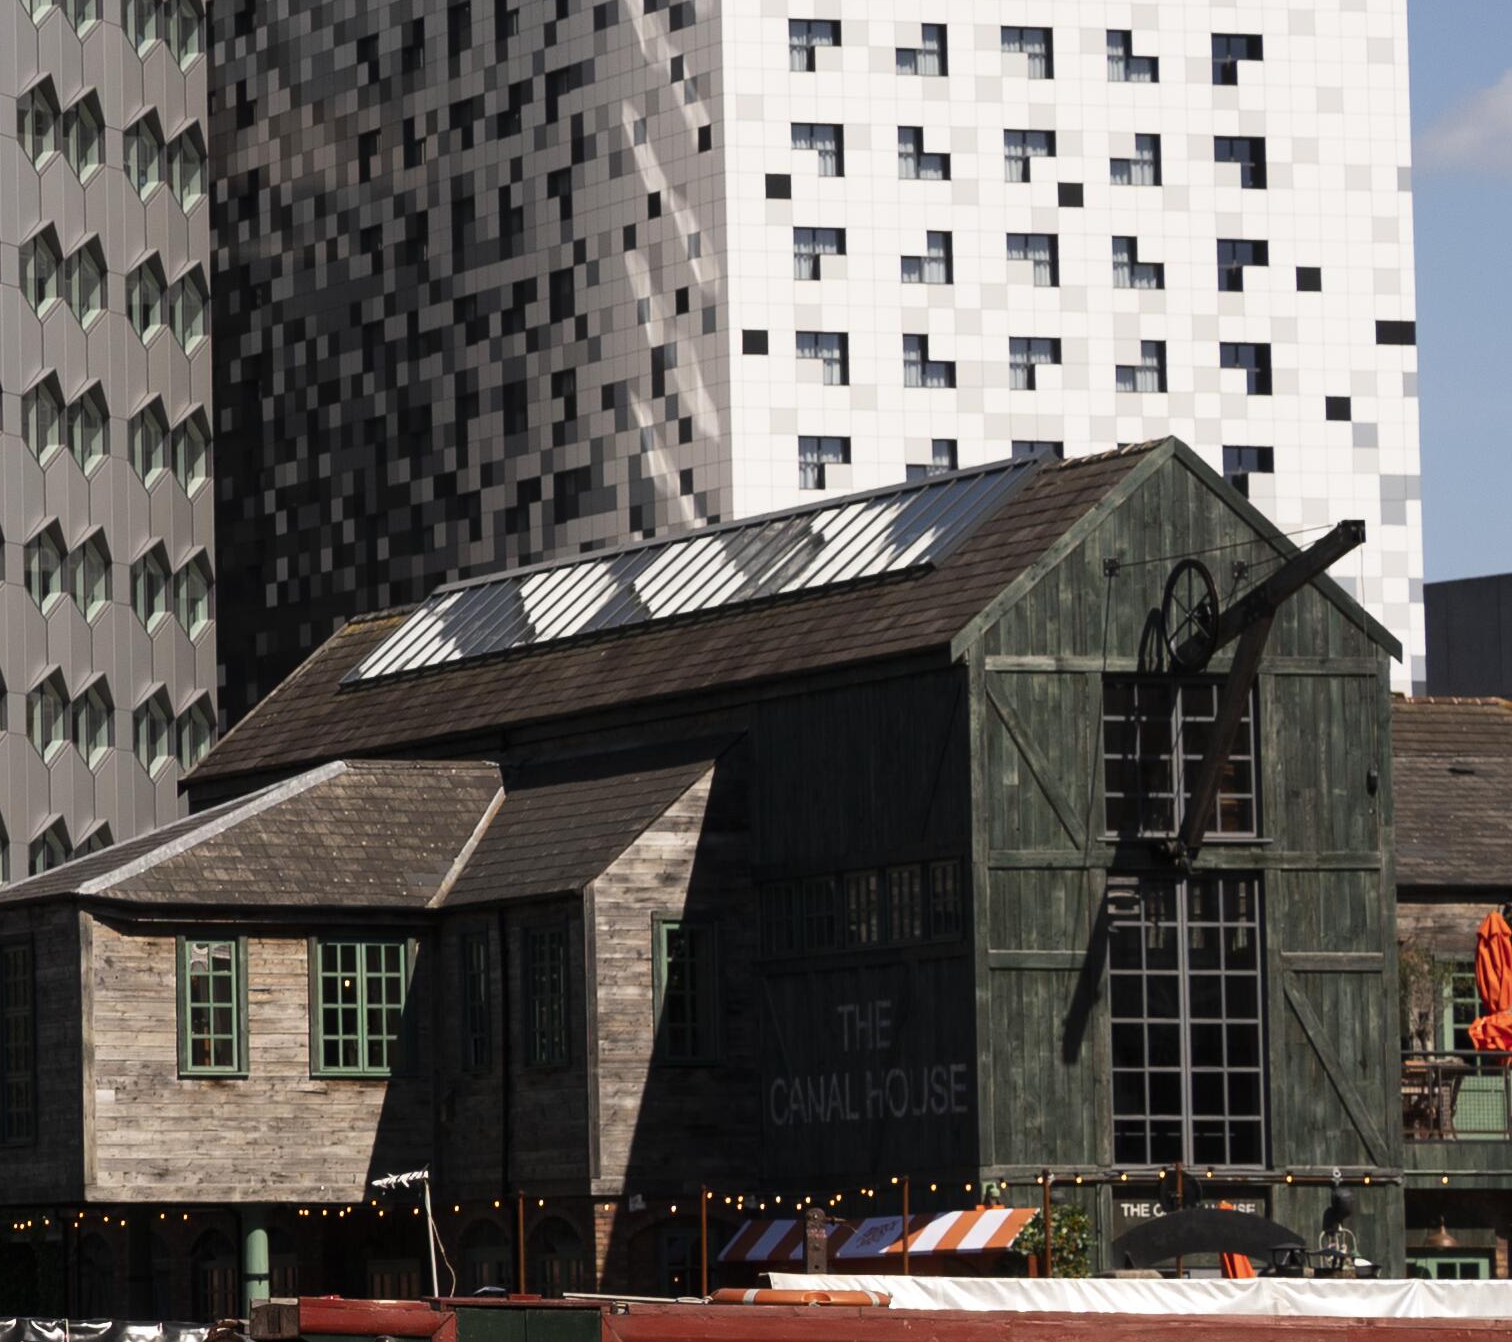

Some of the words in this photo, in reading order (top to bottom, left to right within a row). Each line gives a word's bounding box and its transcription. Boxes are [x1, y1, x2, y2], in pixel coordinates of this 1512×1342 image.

[837, 1000, 892, 1052] THE
[770, 1073, 860, 1126] CANAL
[866, 1064, 968, 1119] HOUSE
[1121, 1203, 1150, 1217] THE
